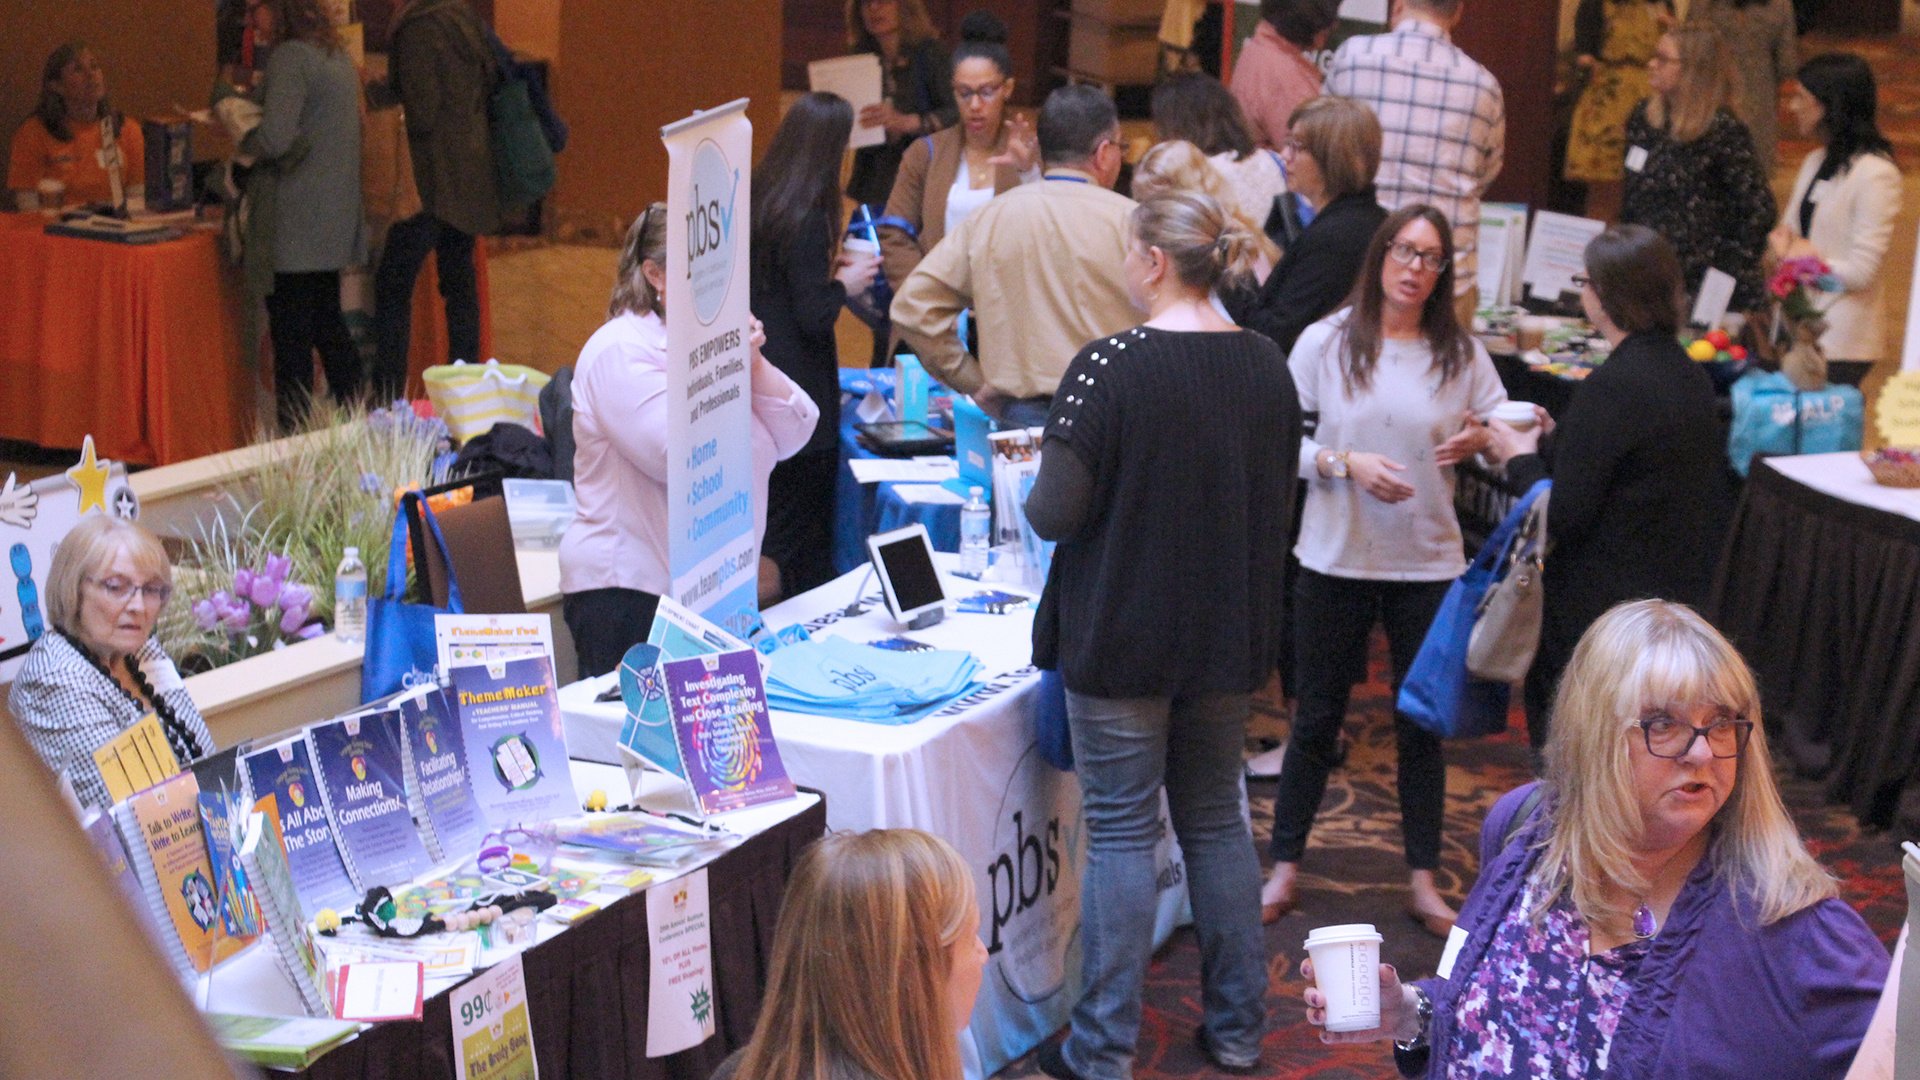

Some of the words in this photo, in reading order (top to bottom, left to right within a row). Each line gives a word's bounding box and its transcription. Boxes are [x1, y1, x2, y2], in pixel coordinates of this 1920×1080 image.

[685, 184, 721, 280] pbs
[699, 328, 741, 364] EMPOWERS
[691, 438, 717, 470] Home
[692, 465, 723, 506] School
[692, 490, 749, 541] Community
[684, 673, 747, 692] Investigating
[459, 684, 548, 706] ThemeMaker
[680, 695, 702, 708] Text
[702, 686, 757, 704] Complexity
[695, 707, 723, 721] Close
[723, 700, 765, 716] Reading
[420, 751, 457, 777] Facilitating
[345, 780, 383, 802] Making
[286, 809, 302, 831] All
[338, 794, 400, 825] Connections!
[147, 819, 163, 836] Talk
[162, 818, 173, 830] to
[150, 836, 171, 852] Write
[170, 831, 180, 843] to
[283, 833, 305, 853] The
[986, 811, 1061, 955] pbs
